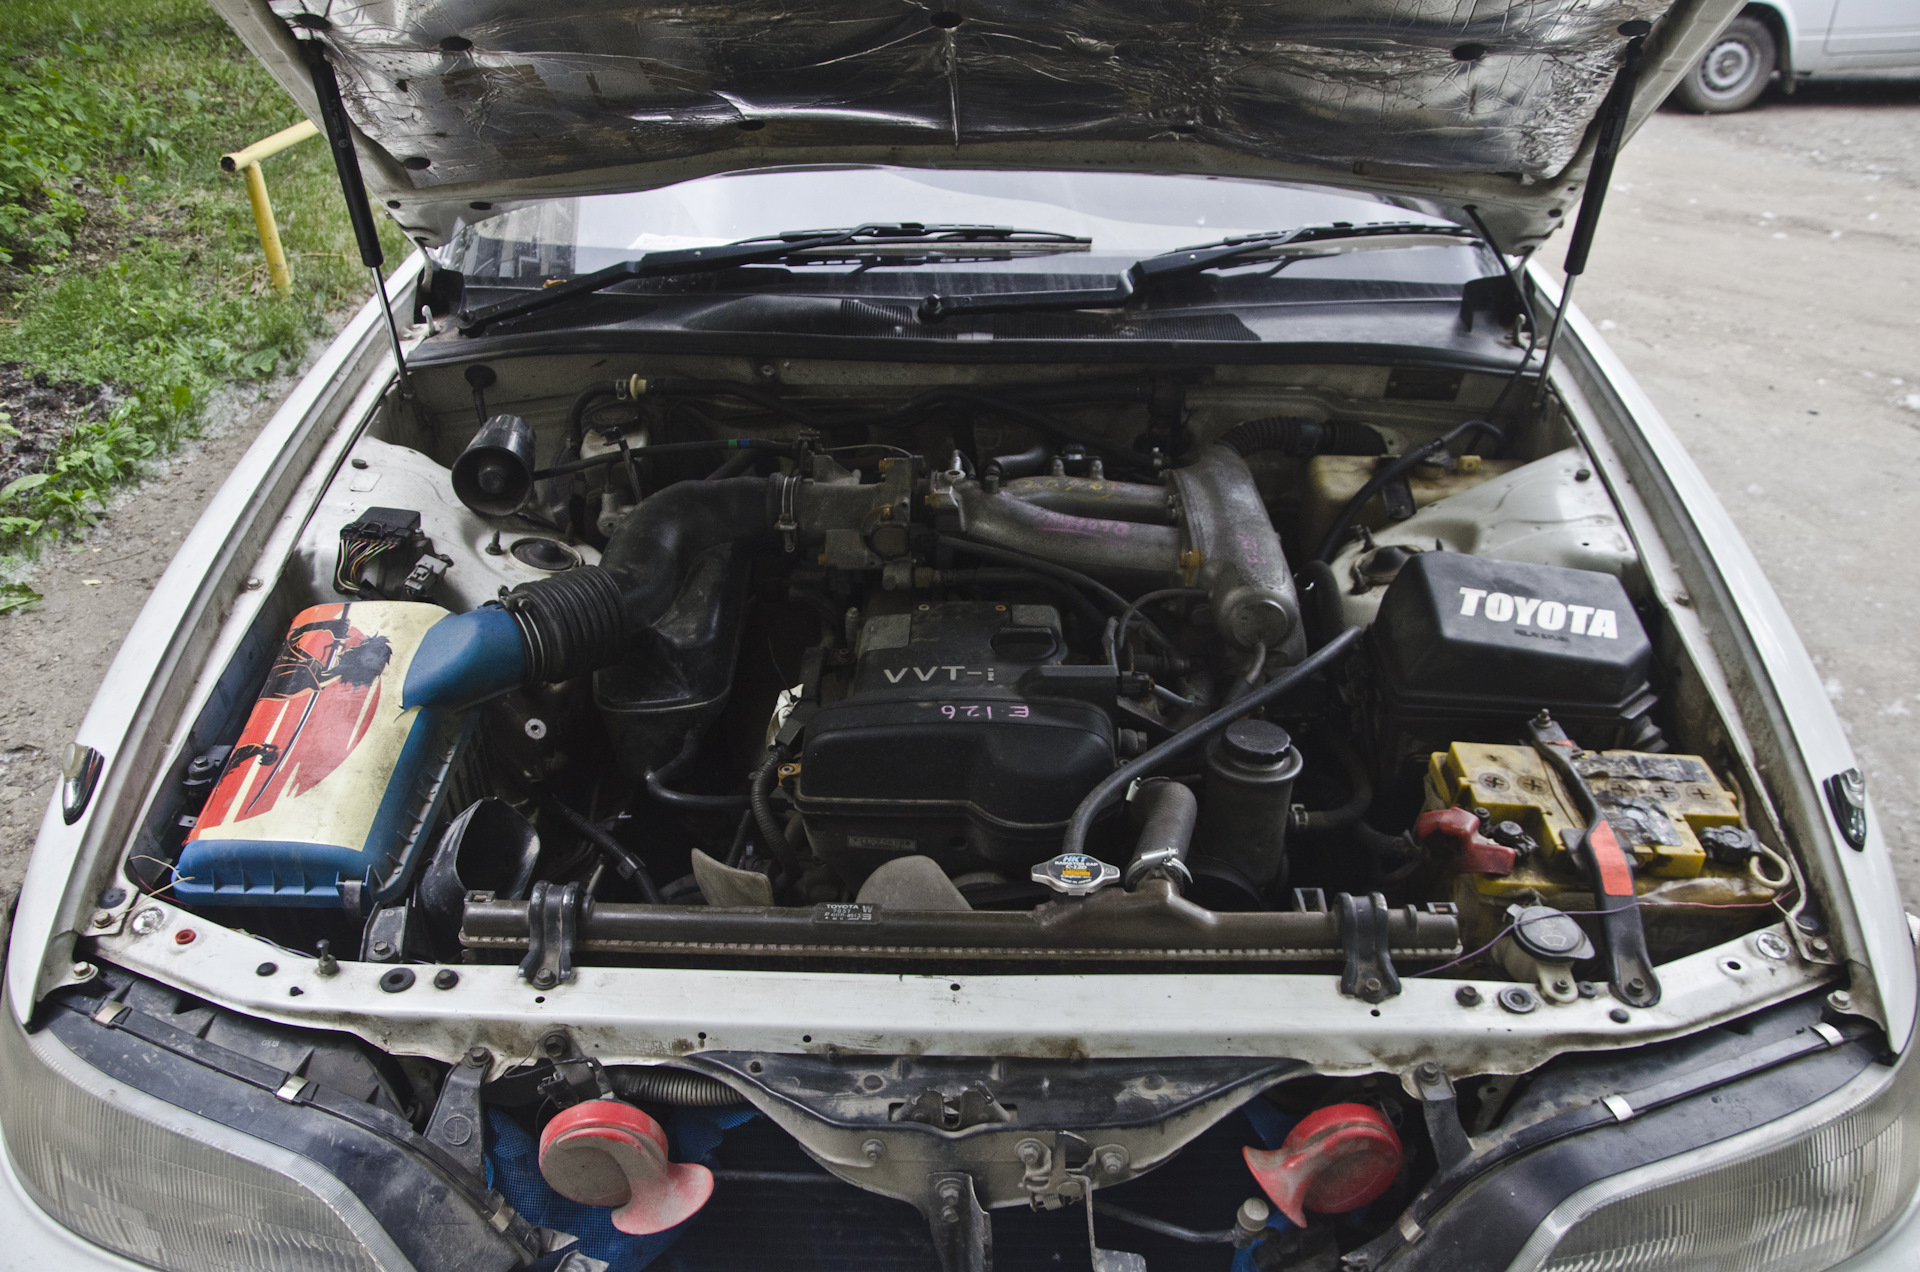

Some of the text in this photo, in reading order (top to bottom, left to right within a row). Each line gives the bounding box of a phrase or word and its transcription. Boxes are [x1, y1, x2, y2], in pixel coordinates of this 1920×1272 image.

[1459, 586, 1619, 640] TOYOTA
[883, 665, 995, 684] VVT-i
[1062, 855, 1089, 863] HKT
